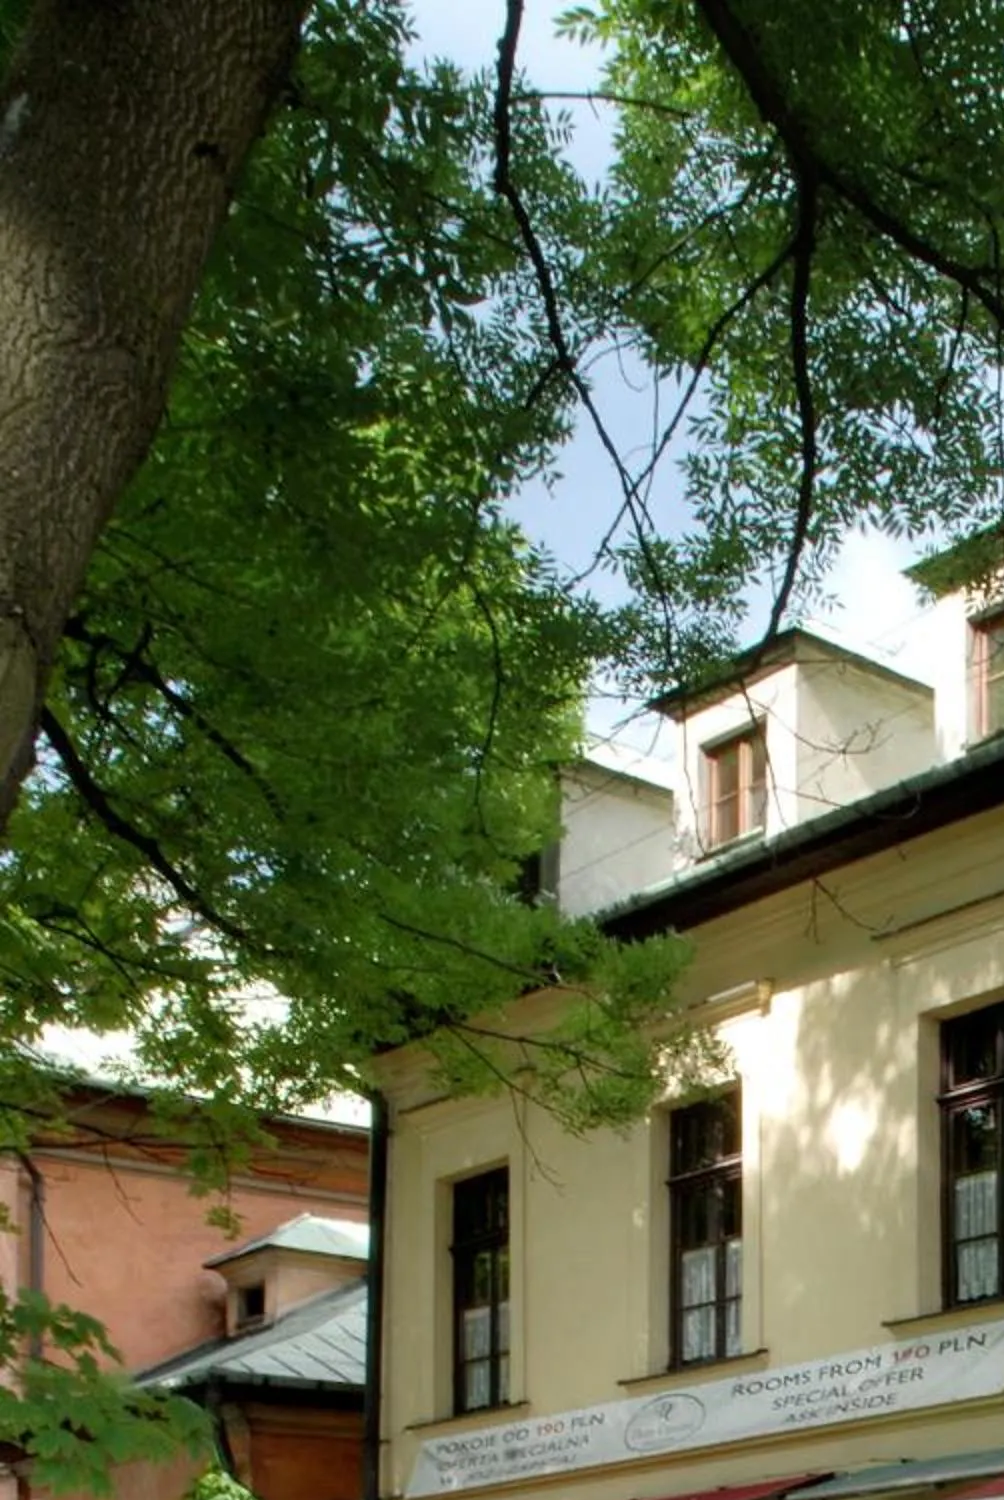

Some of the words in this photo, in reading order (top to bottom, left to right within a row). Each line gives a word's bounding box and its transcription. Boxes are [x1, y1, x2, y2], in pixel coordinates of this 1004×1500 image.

[731, 1370, 811, 1398] ROOMS
[818, 1355, 882, 1382] FROM
[938, 1333, 987, 1356] PLN
[772, 1386, 847, 1411] SPECIAL
[858, 1366, 924, 1392] OFFER
[826, 1392, 897, 1416] INSIDE
[502, 1428, 529, 1445] OD
[536, 1421, 565, 1438] 190
[570, 1412, 606, 1432] PLN
